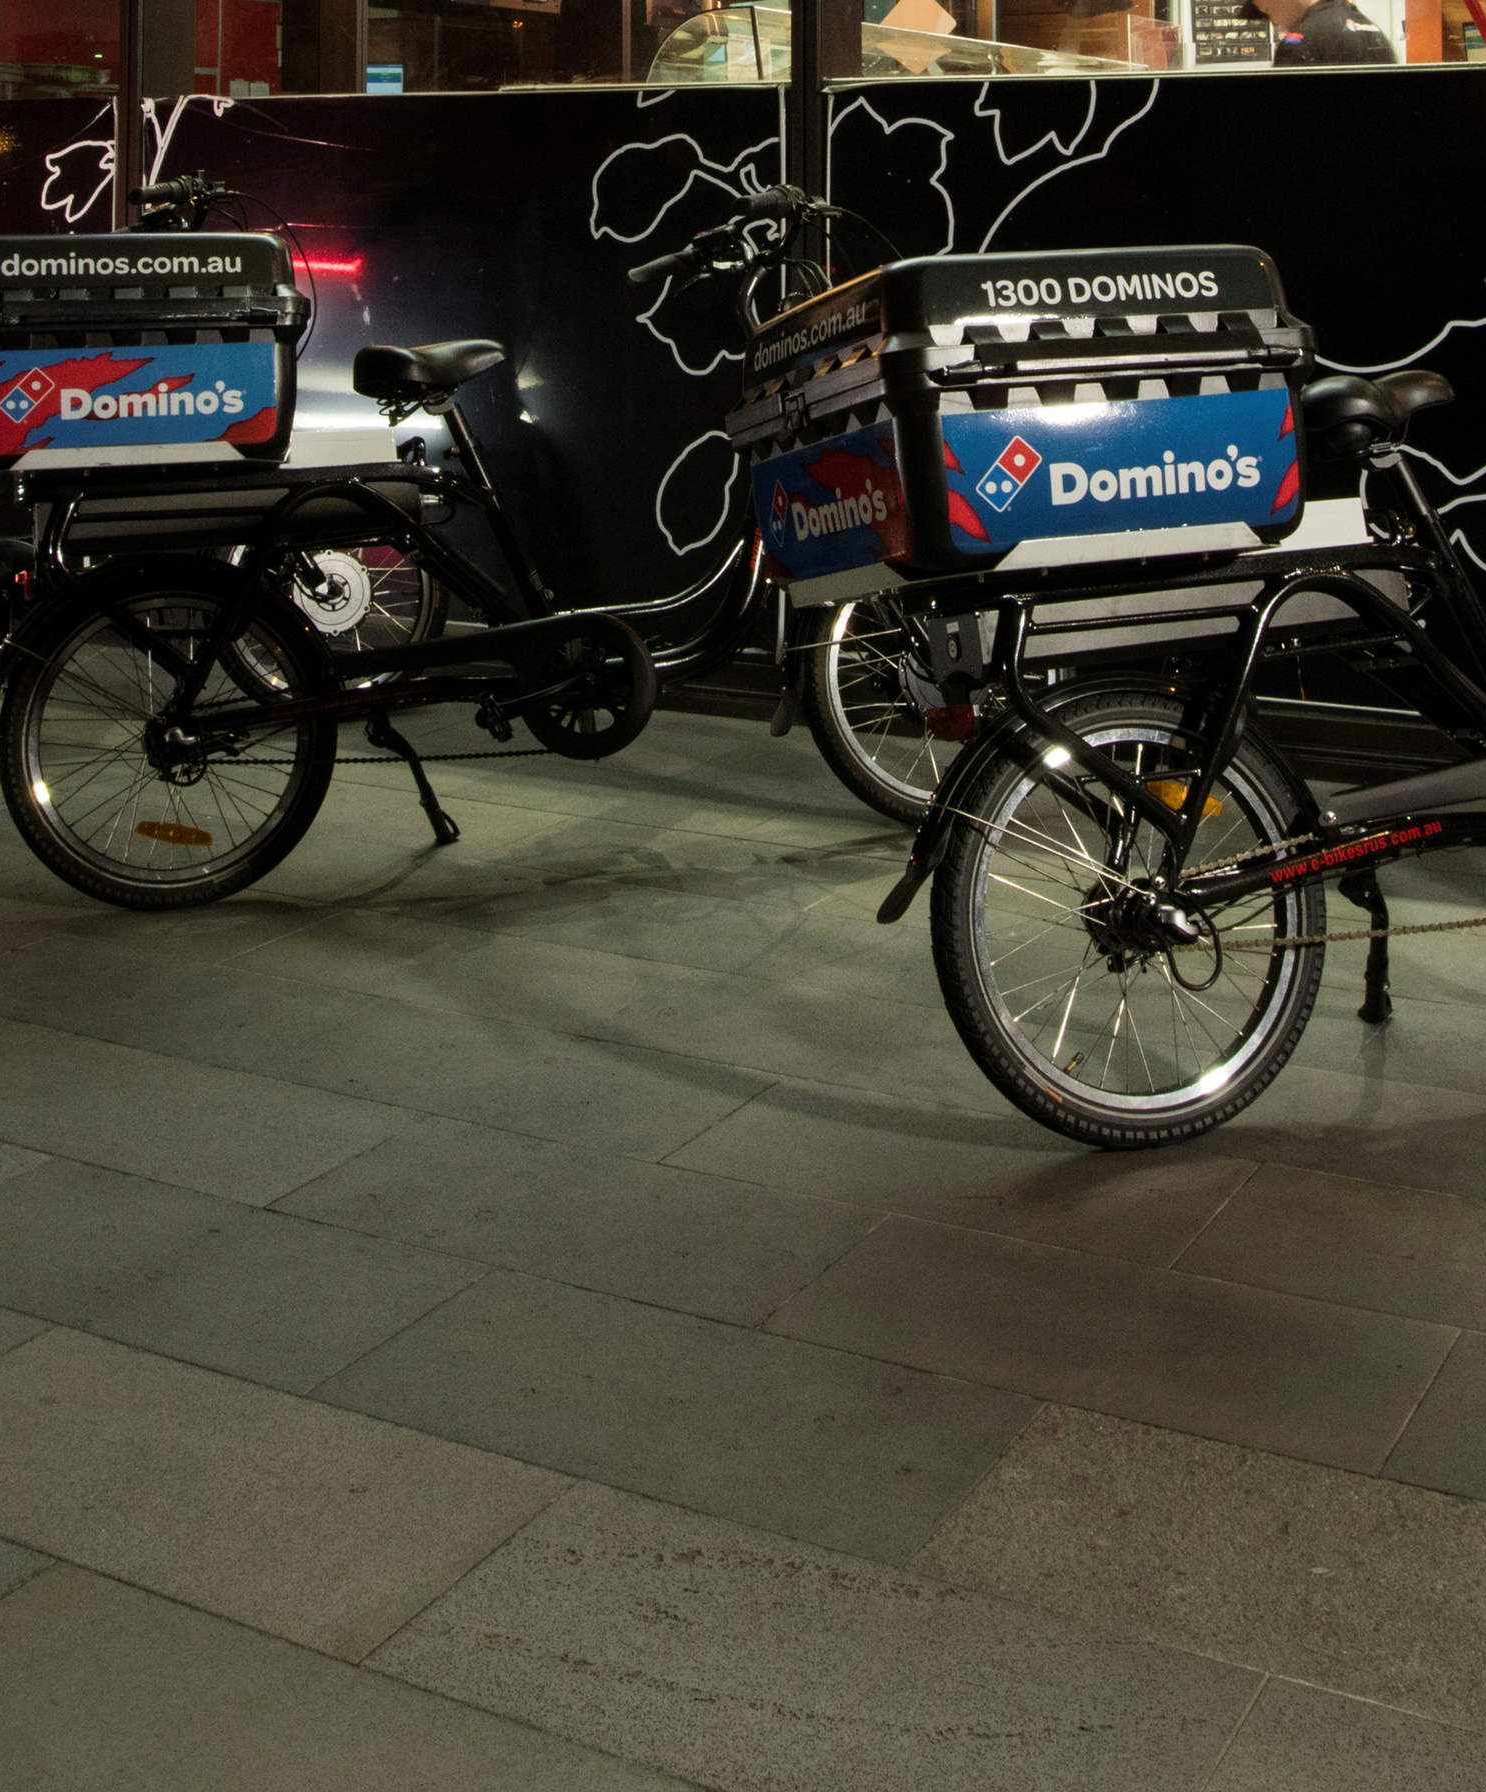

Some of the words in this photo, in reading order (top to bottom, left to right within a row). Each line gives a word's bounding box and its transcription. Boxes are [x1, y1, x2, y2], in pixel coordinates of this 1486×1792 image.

[0, 251, 242, 277] dominos.com.au
[981, 277, 1063, 309] 1300
[1068, 270, 1219, 305] DOMINOS
[752, 302, 867, 374] dominos.com.au
[59, 380, 245, 422] Domino's
[1049, 443, 1262, 507] Domino's
[790, 478, 888, 543] Domino's
